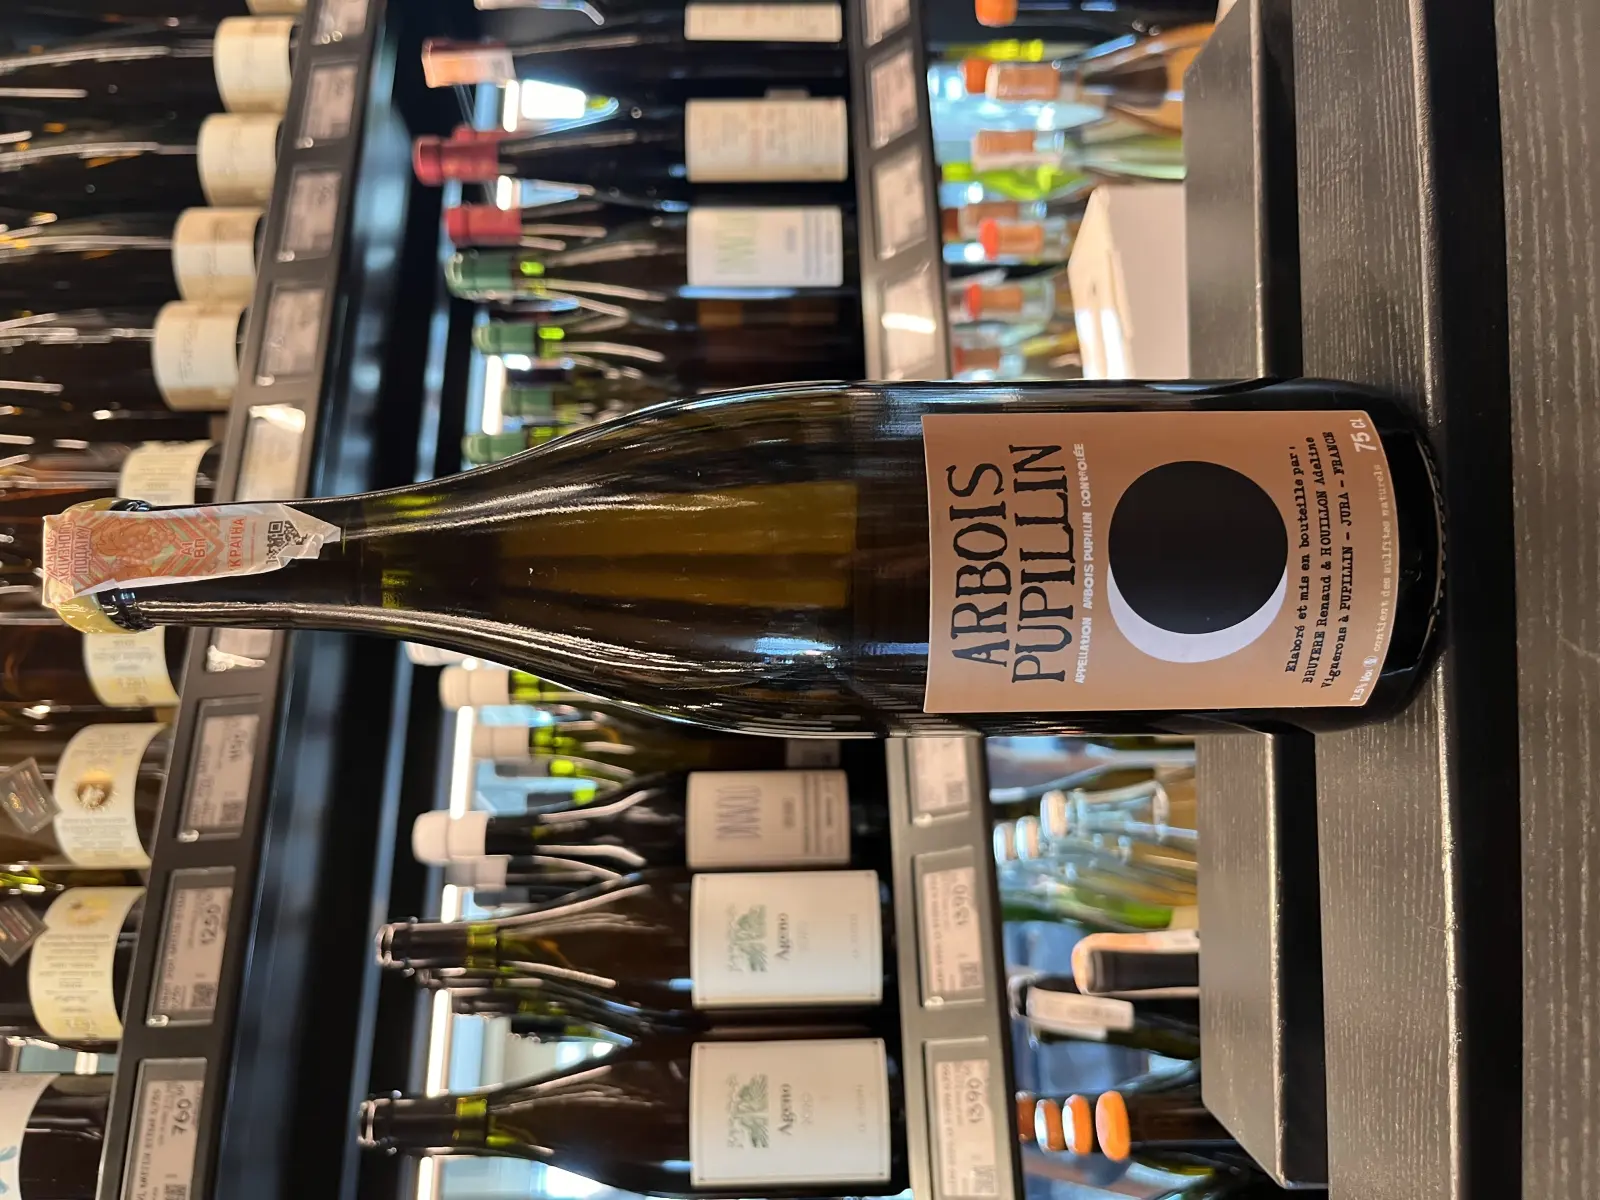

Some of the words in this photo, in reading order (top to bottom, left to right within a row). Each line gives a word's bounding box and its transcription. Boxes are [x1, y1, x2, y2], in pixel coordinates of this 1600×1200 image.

[1305, 437, 1326, 485] Adeline
[1322, 432, 1345, 475] FRANCE
[1350, 431, 1378, 453] 75
[1294, 479, 1310, 548] bouteille
[1338, 492, 1352, 526] JURA
[1373, 464, 1390, 517] naturels
[229, 518, 245, 570] КРАЇНА
[1082, 512, 1093, 561] PUPILLIN
[1316, 490, 1332, 556] HOUILLON
[73, 527, 89, 573] ПОДАТКУ
[945, 463, 1012, 667] ARBOIS
[1008, 445, 1076, 684] PUPILLIN
[1301, 554, 1310, 571] en
[1321, 561, 1331, 571] &
[1082, 564, 1094, 609] ARBOIS
[1299, 576, 1310, 601] mis
[1316, 575, 1332, 627] Renaud
[1339, 546, 1353, 610] PUPILLIN
[1380, 578, 1391, 597] des
[1297, 605, 1308, 620] et
[1338, 615, 1349, 623] à
[1373, 601, 1389, 652] contient
[1285, 625, 1305, 672] Elaboré
[1302, 631, 1325, 684] BRUYERE
[1321, 627, 1347, 689] Vignerons
[170, 1098, 192, 1137] 760
